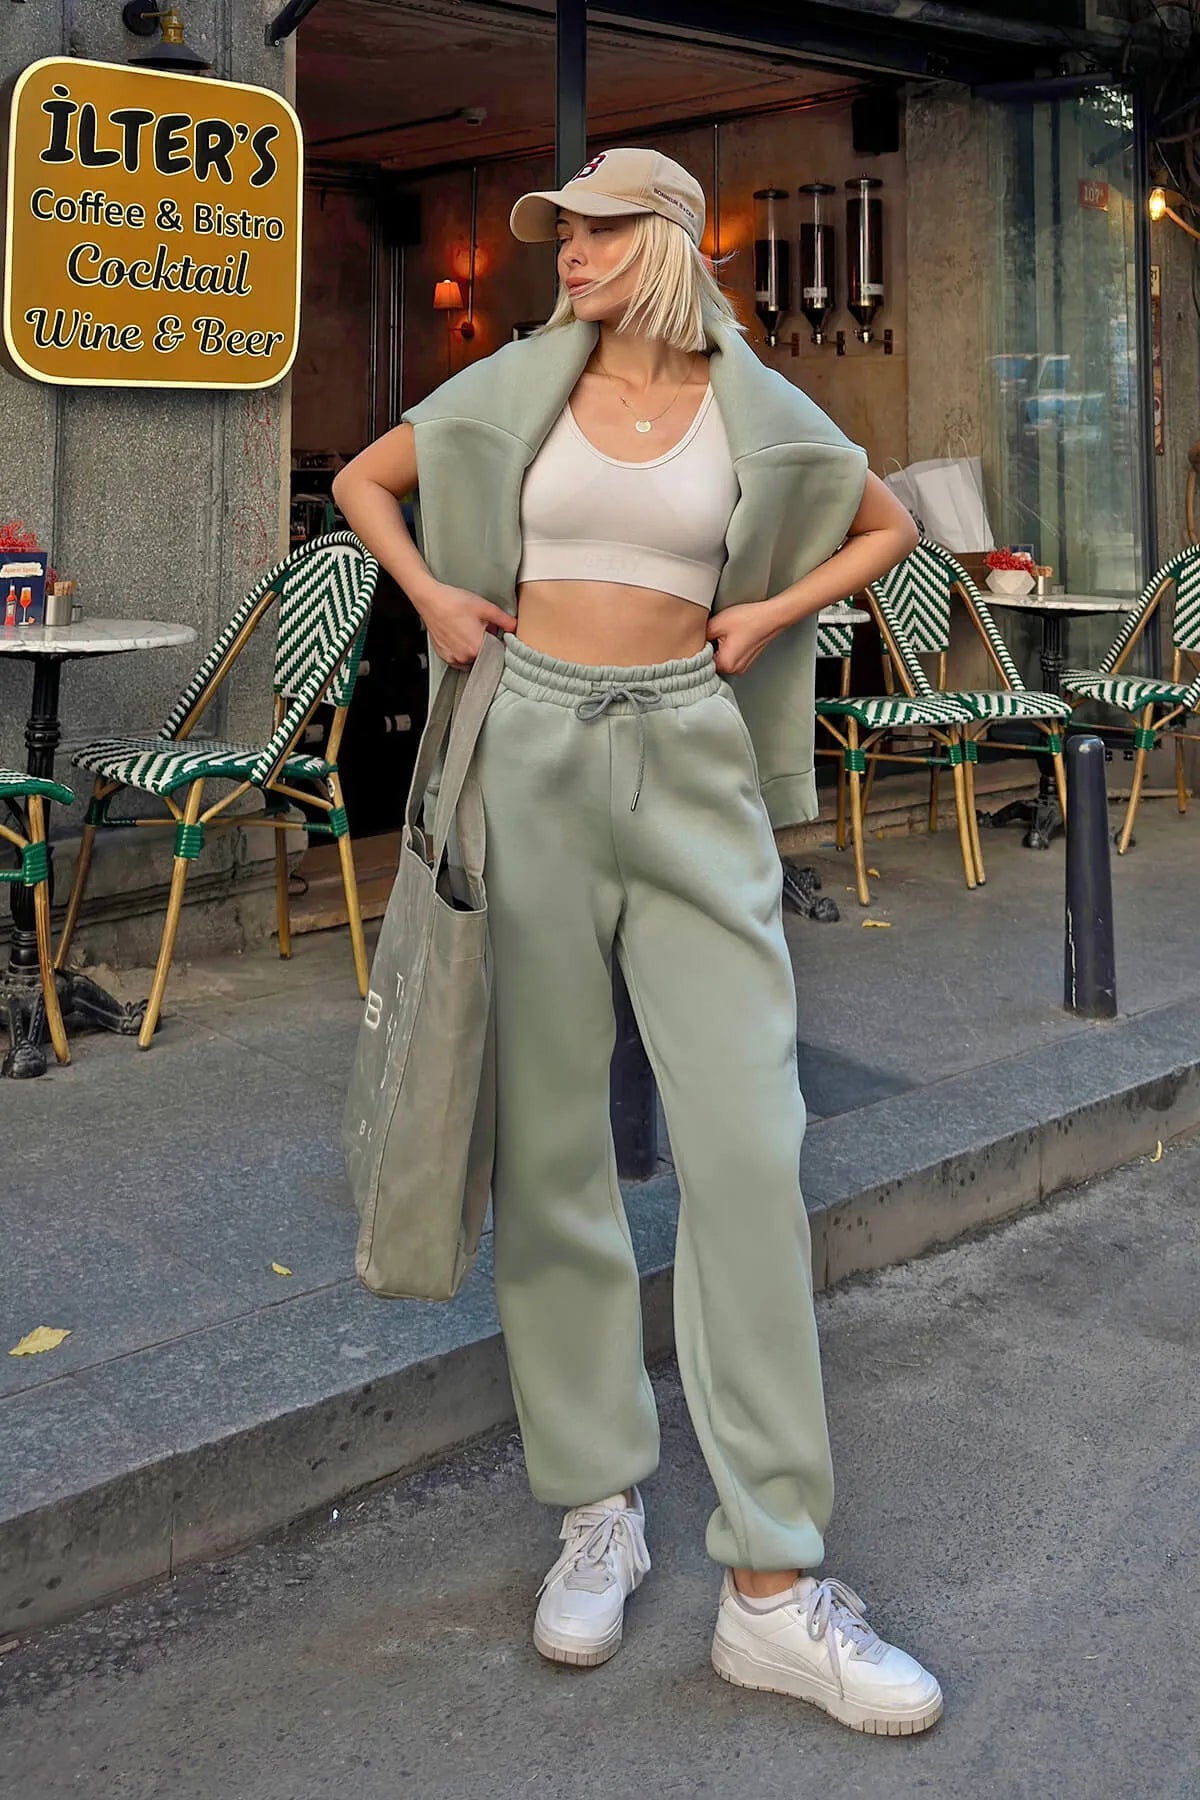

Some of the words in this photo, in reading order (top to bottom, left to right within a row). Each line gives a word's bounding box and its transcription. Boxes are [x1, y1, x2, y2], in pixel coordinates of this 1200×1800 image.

[31, 187, 146, 229] Coffee
[154, 198, 184, 232] &
[193, 202, 284, 241] Bistro
[66, 241, 252, 296] Cocktail
[24, 307, 144, 352] Wine
[153, 314, 185, 353] &
[192, 315, 284, 357] Beer
